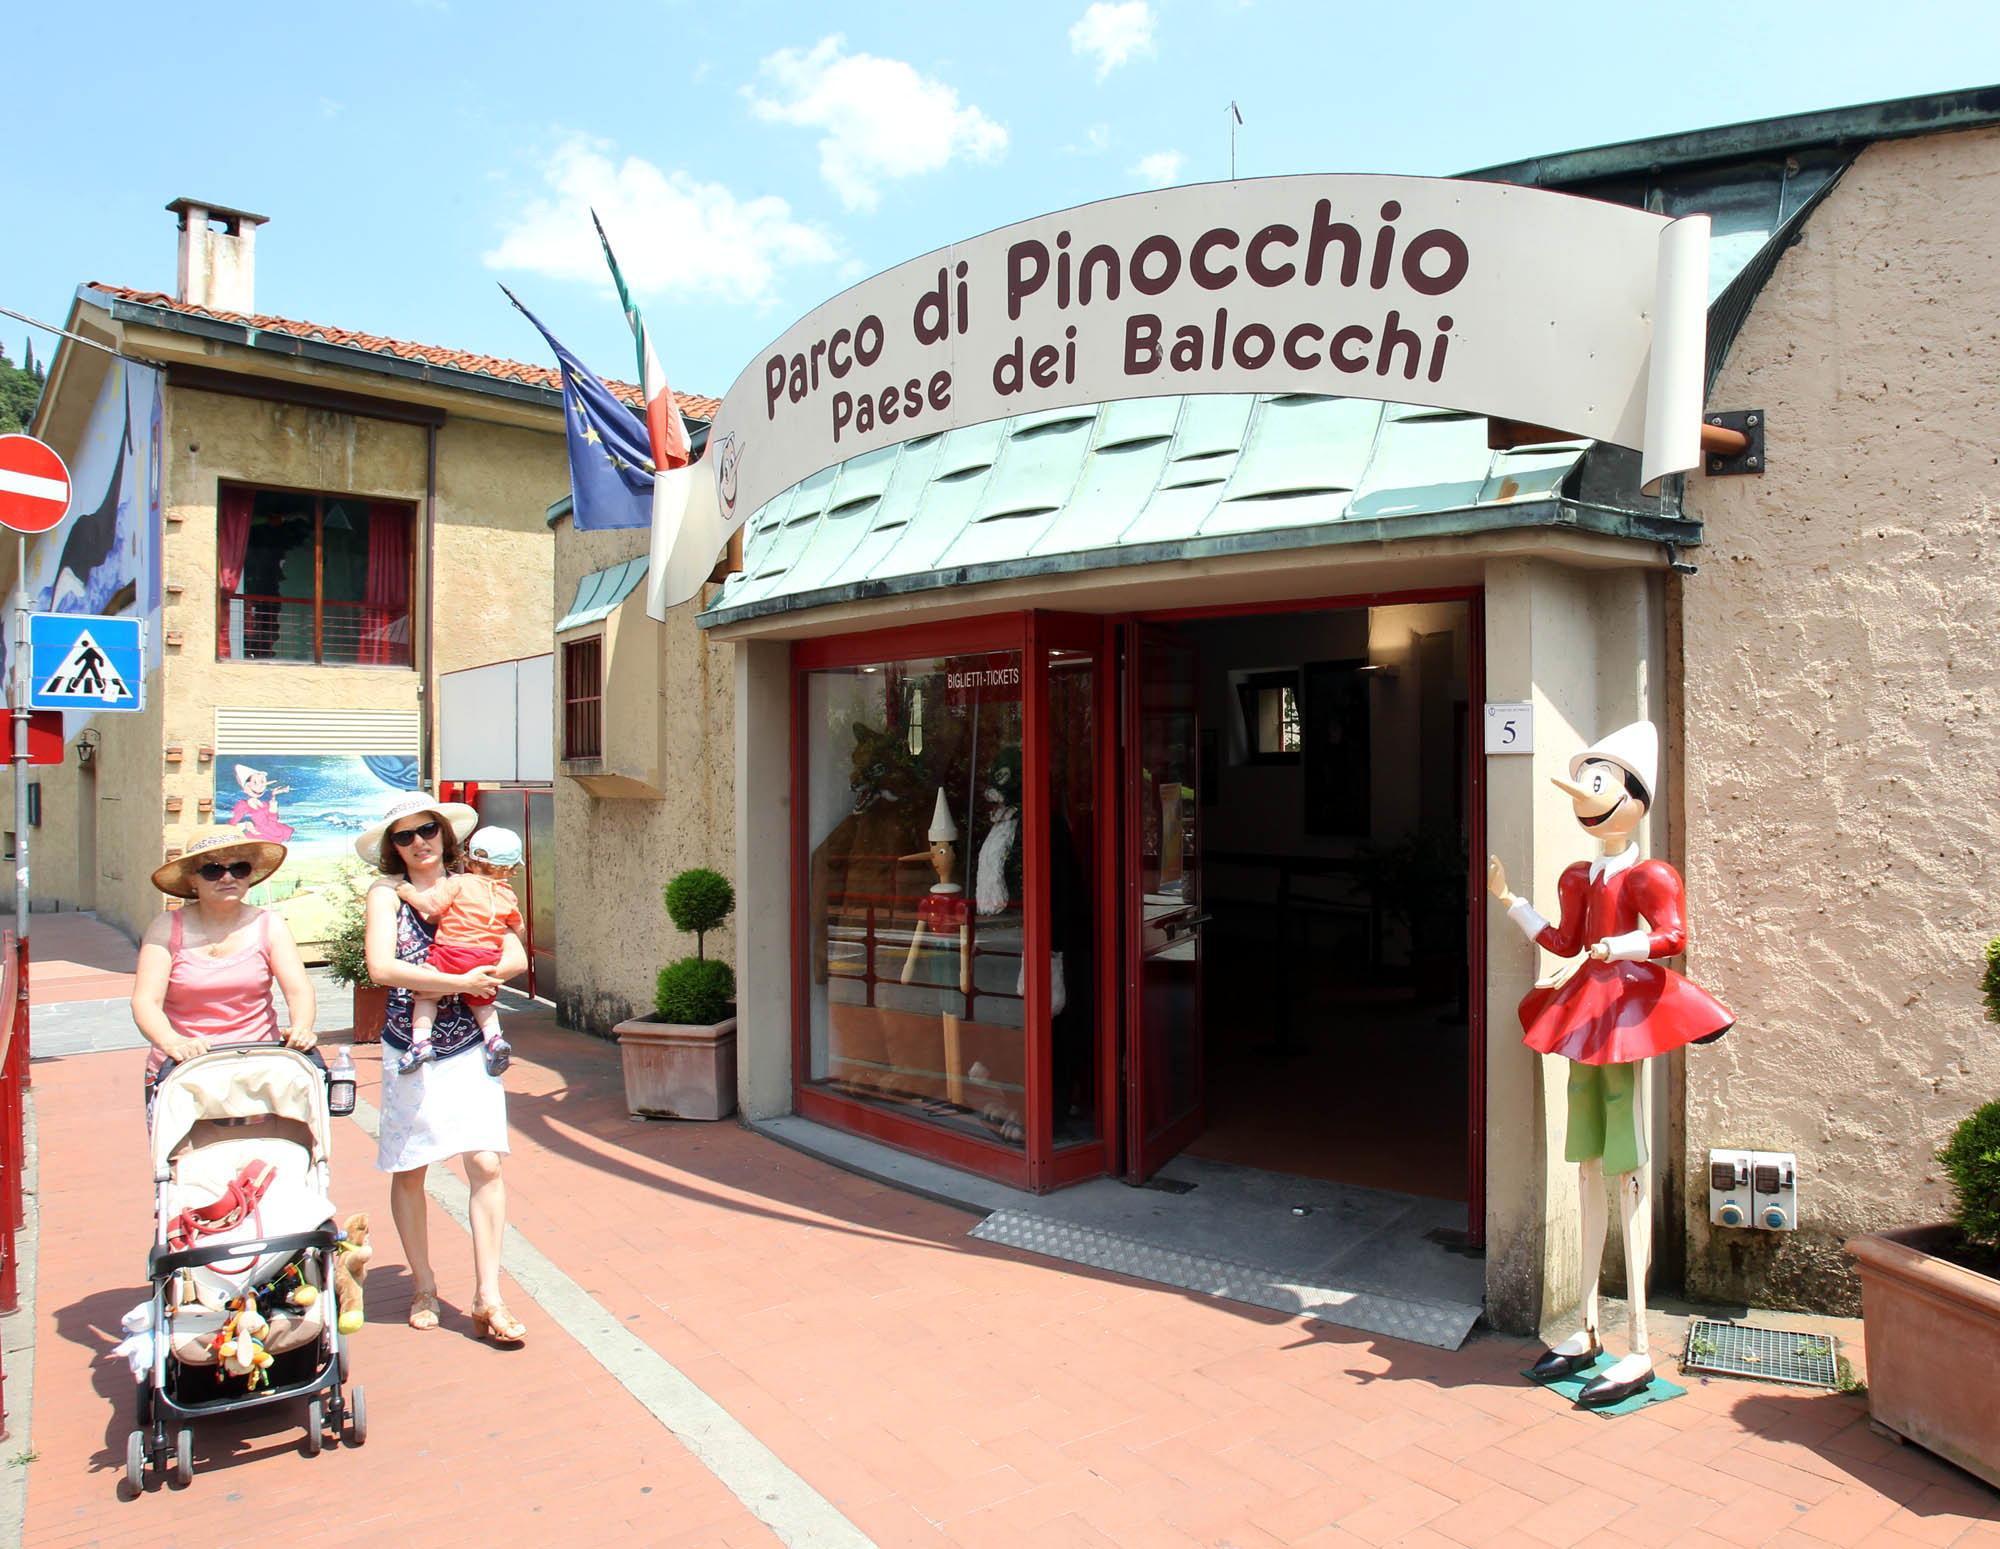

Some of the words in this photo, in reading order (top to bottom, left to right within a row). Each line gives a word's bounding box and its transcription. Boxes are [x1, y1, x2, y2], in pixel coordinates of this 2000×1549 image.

[766, 315, 884, 421] Parco
[914, 261, 969, 346] di
[1008, 199, 1469, 321] Pinocchio
[833, 371, 952, 444] Paese
[993, 325, 1078, 397] dei
[1124, 308, 1449, 383] Balocchi
[1502, 720, 1517, 744] 5
